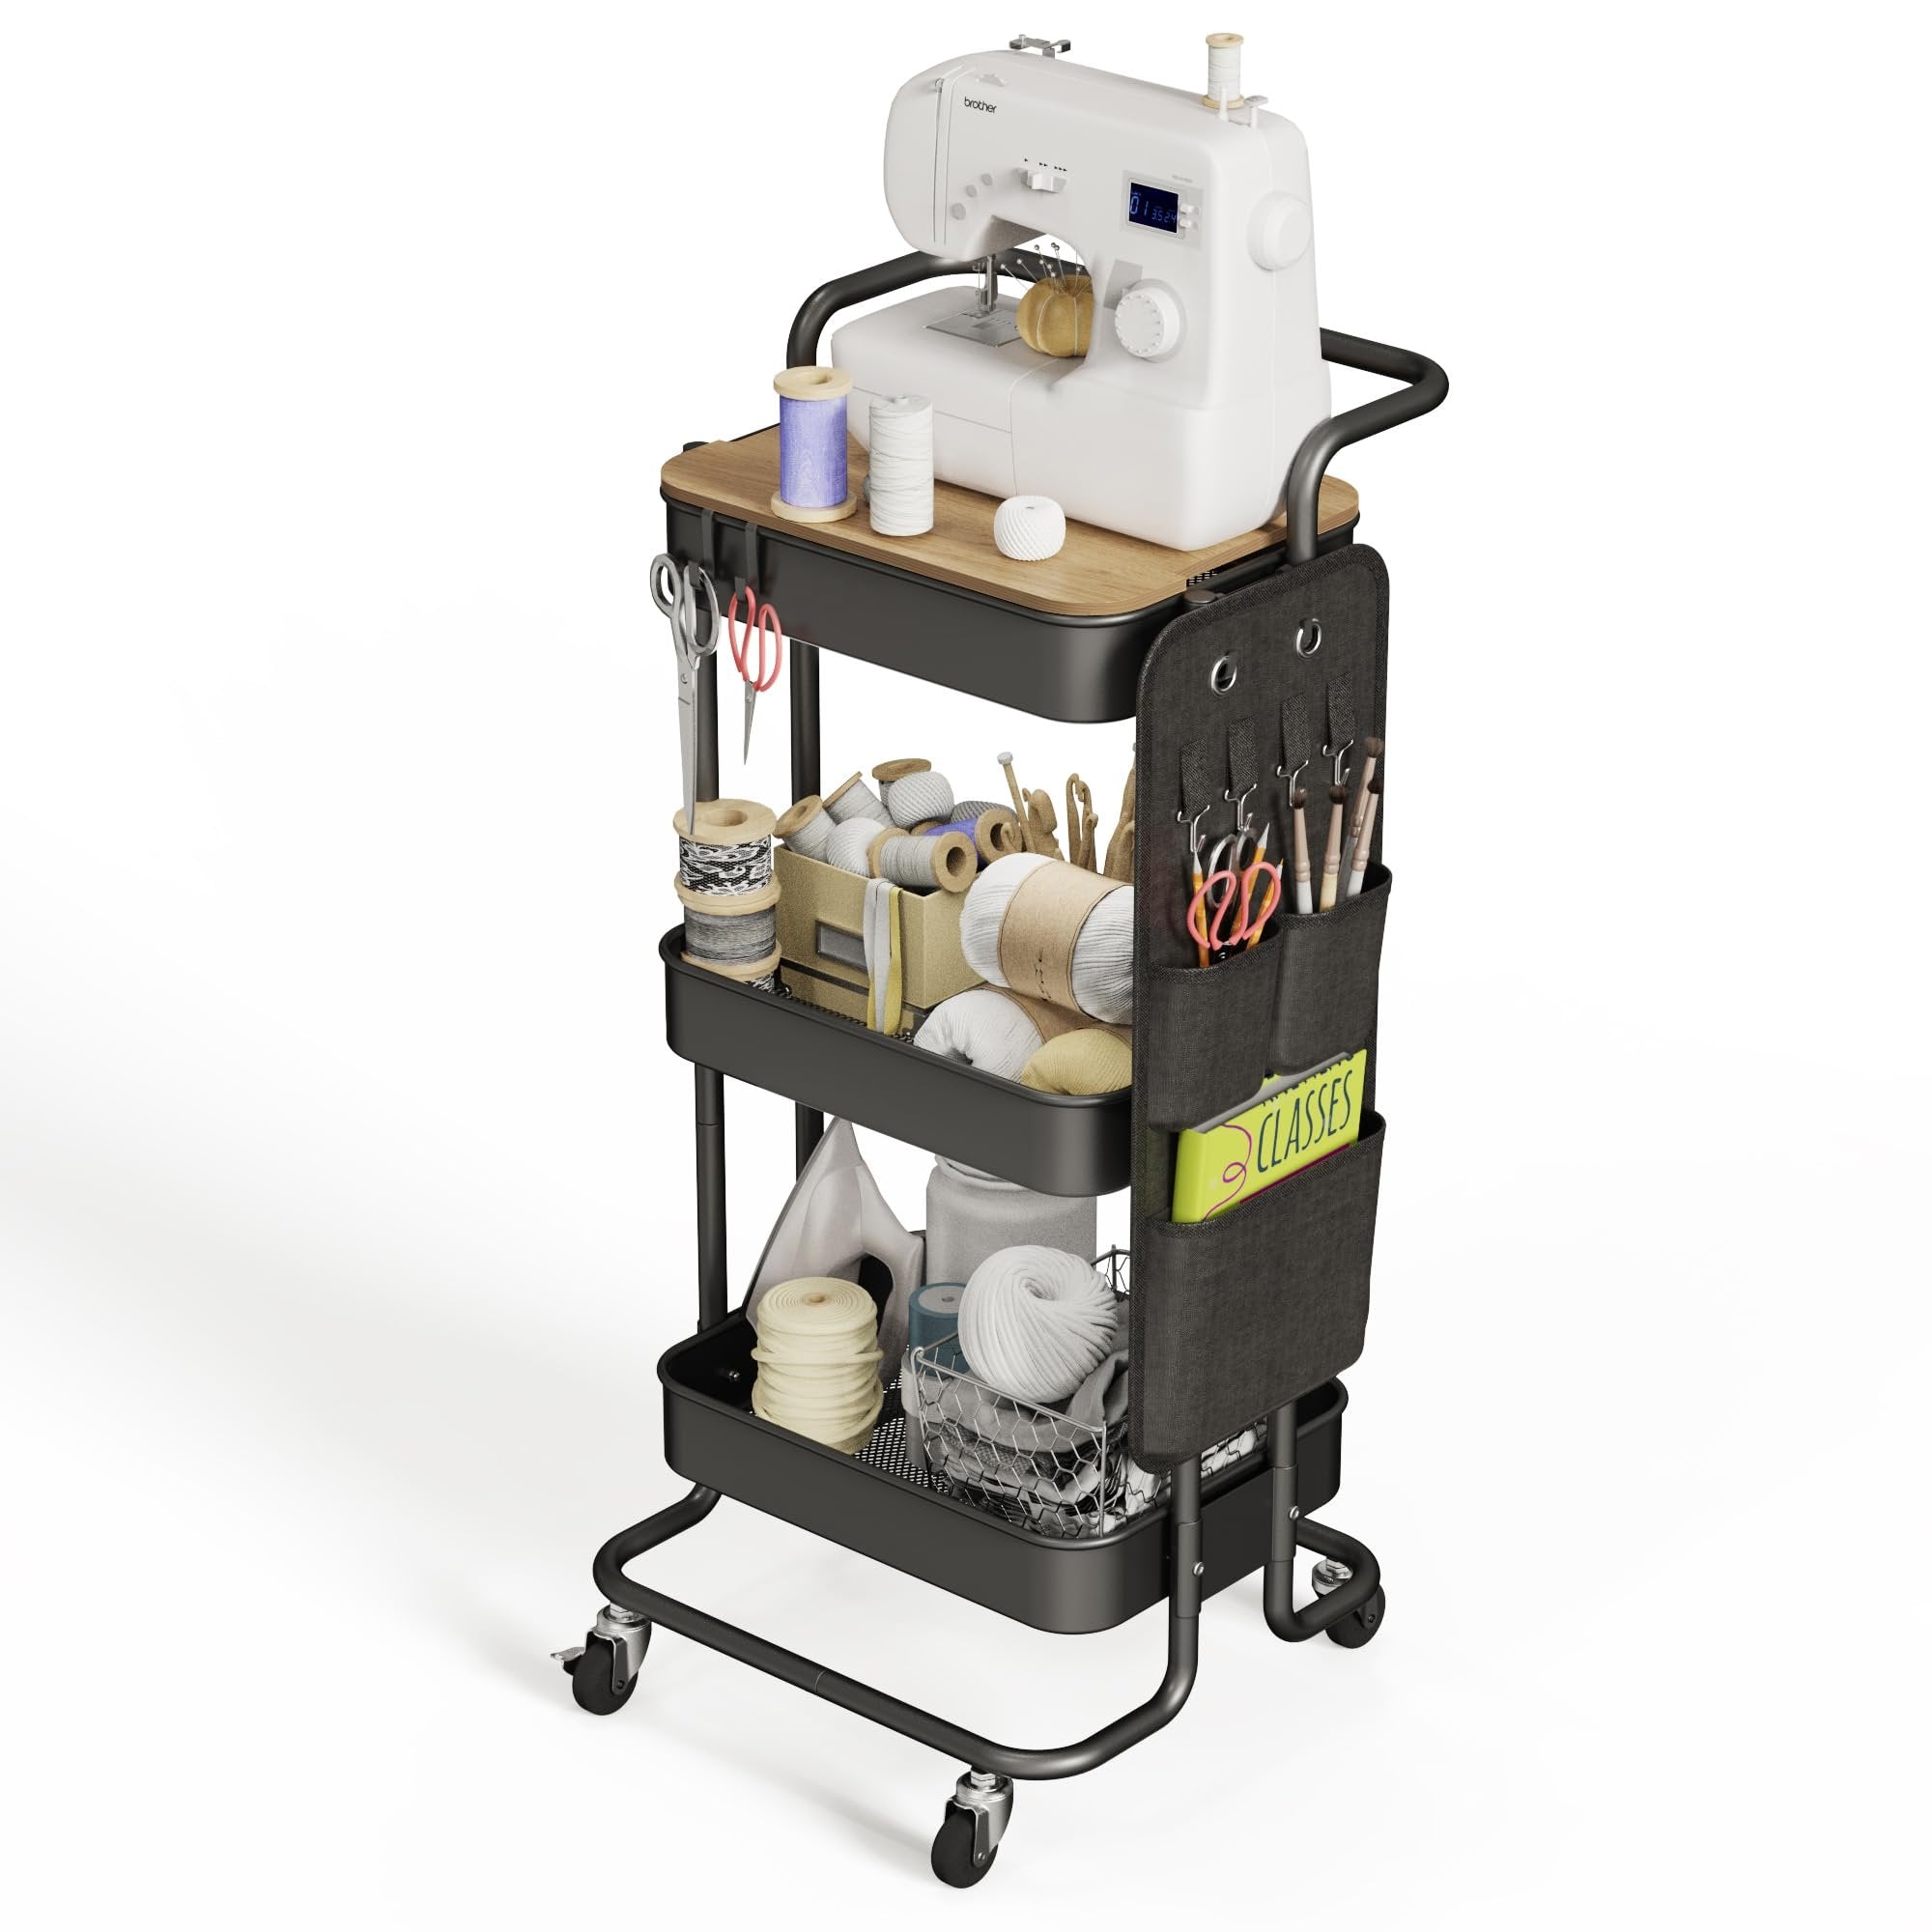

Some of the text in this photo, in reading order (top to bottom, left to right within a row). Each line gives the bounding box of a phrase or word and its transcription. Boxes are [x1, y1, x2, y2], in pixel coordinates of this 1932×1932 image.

[964, 96, 997, 113] brother
[1130, 195, 1149, 216] 01
[1257, 1069, 1353, 1173] CLASSES
